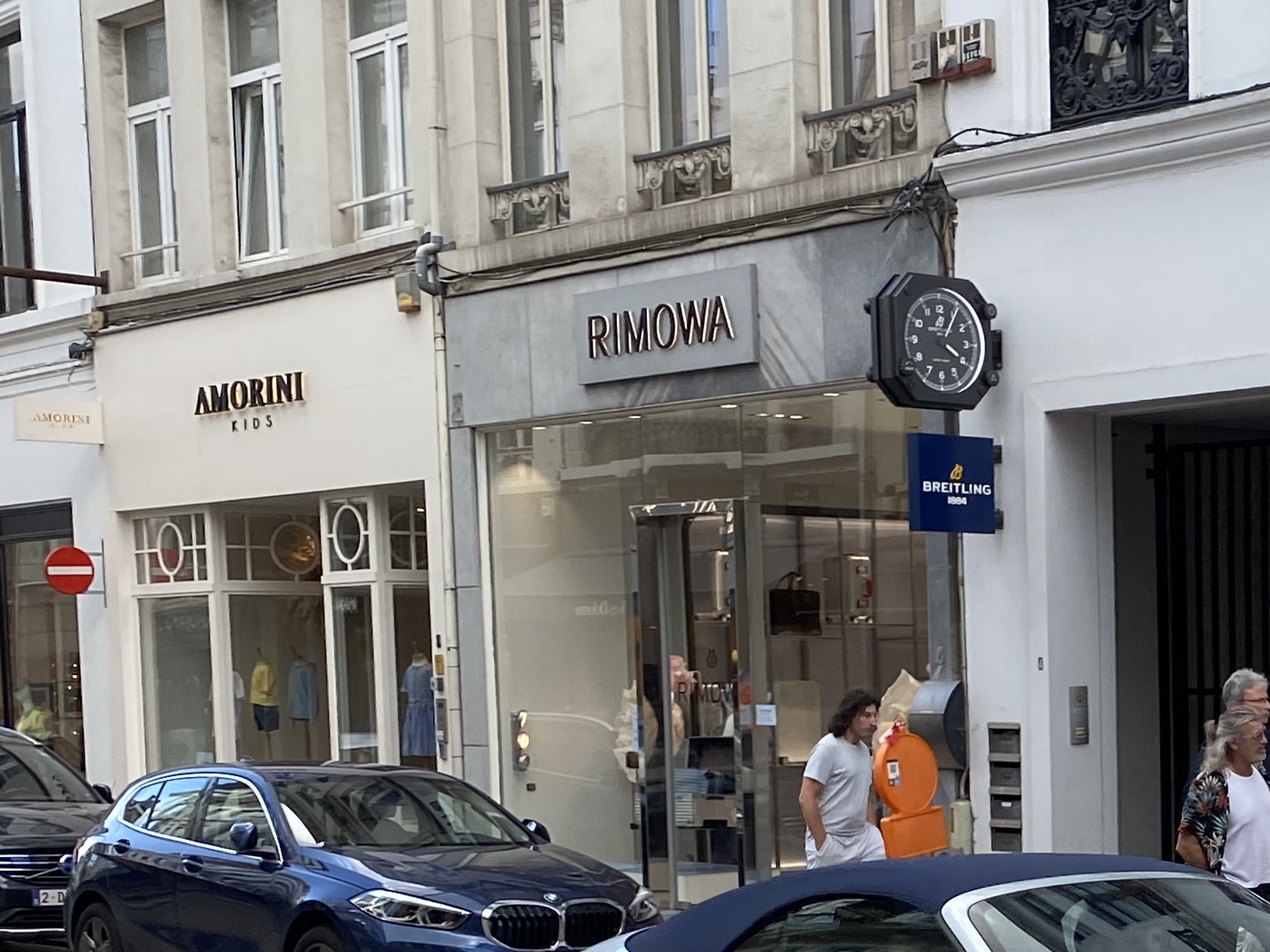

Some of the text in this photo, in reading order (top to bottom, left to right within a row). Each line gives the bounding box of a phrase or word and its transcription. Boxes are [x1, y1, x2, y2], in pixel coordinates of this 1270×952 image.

[935, 304, 944, 314] 12
[587, 295, 735, 359] RIMOWA
[914, 319, 924, 328] 10
[959, 323, 965, 333] 2
[962, 340, 969, 349] 3
[938, 371, 945, 380] 6
[194, 371, 305, 415] AMORINI
[32, 412, 91, 425] AMORINI
[231, 415, 274, 432] KIDS
[922, 480, 992, 495] BREITLING
[947, 495, 968, 506] 1884
